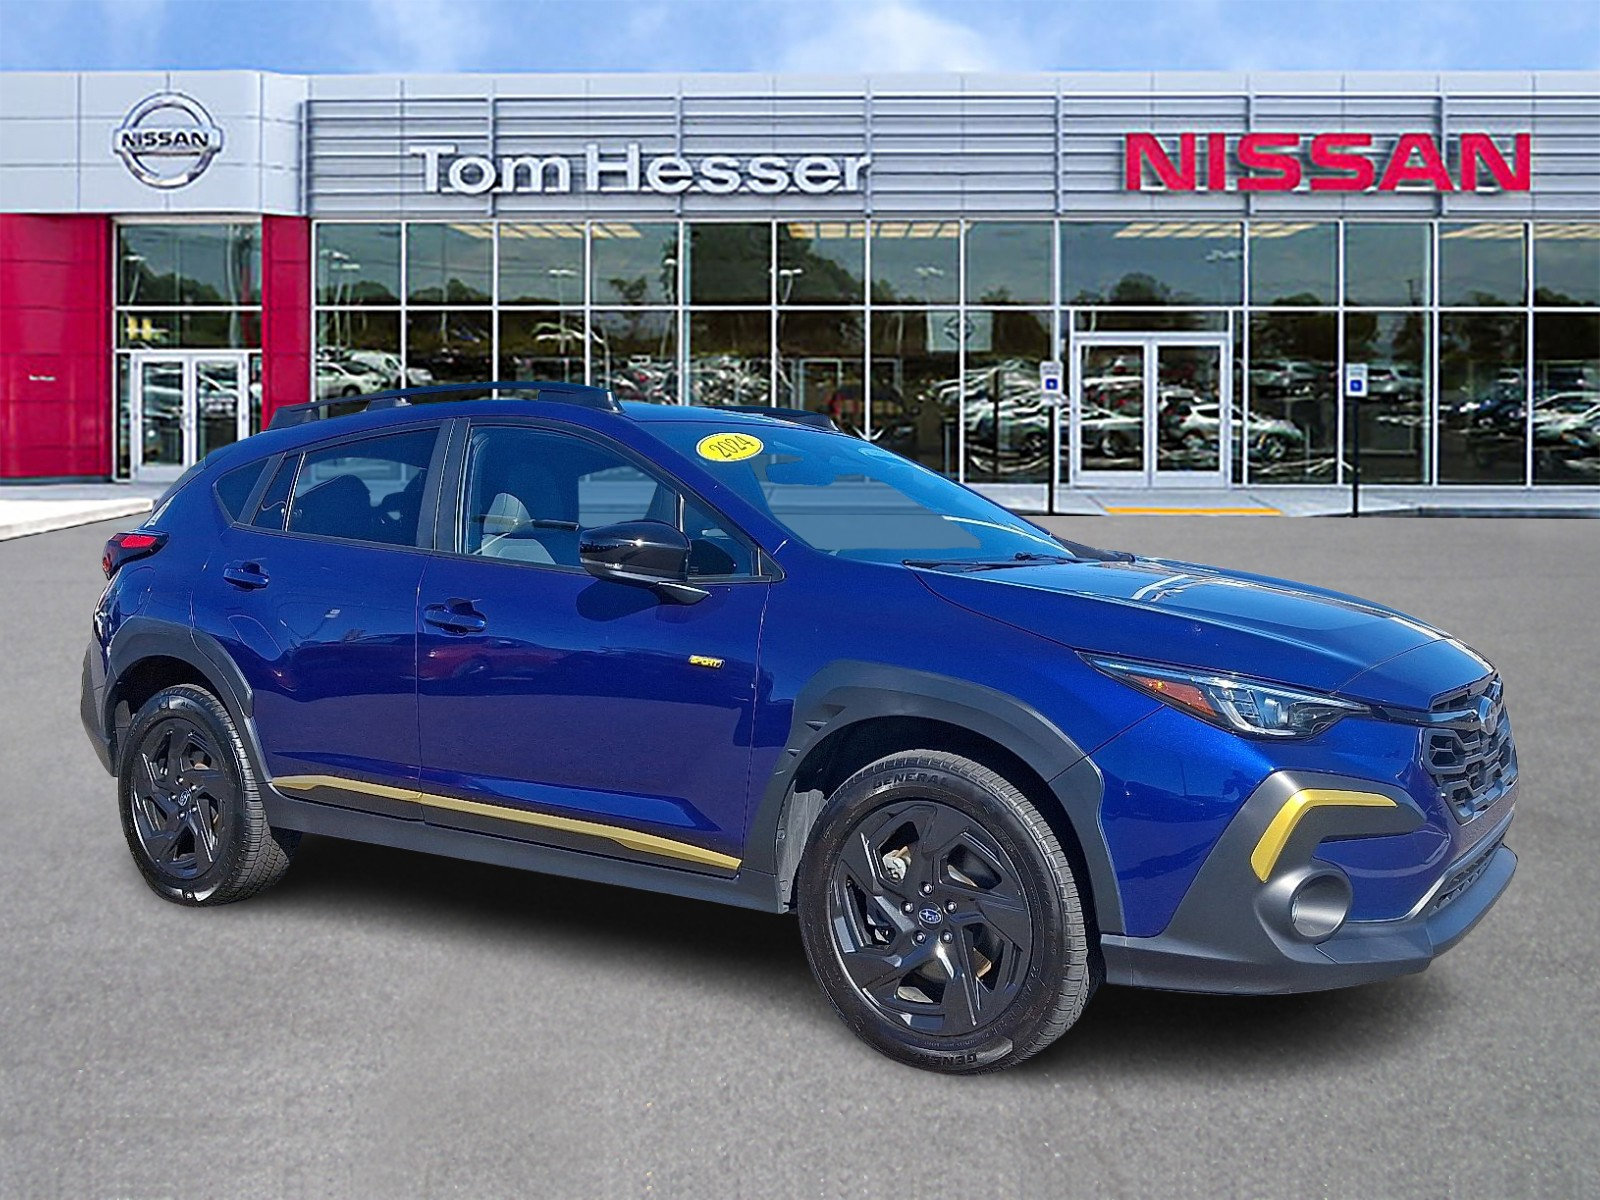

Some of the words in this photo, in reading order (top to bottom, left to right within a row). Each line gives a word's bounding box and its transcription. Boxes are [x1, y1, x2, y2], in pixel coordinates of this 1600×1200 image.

[122, 131, 209, 147] NISSAN
[409, 144, 570, 194] Tom
[585, 143, 871, 194] Hesser
[1125, 132, 1531, 191] NISSAN
[708, 435, 755, 458] 2024
[690, 655, 721, 668] SPORT
